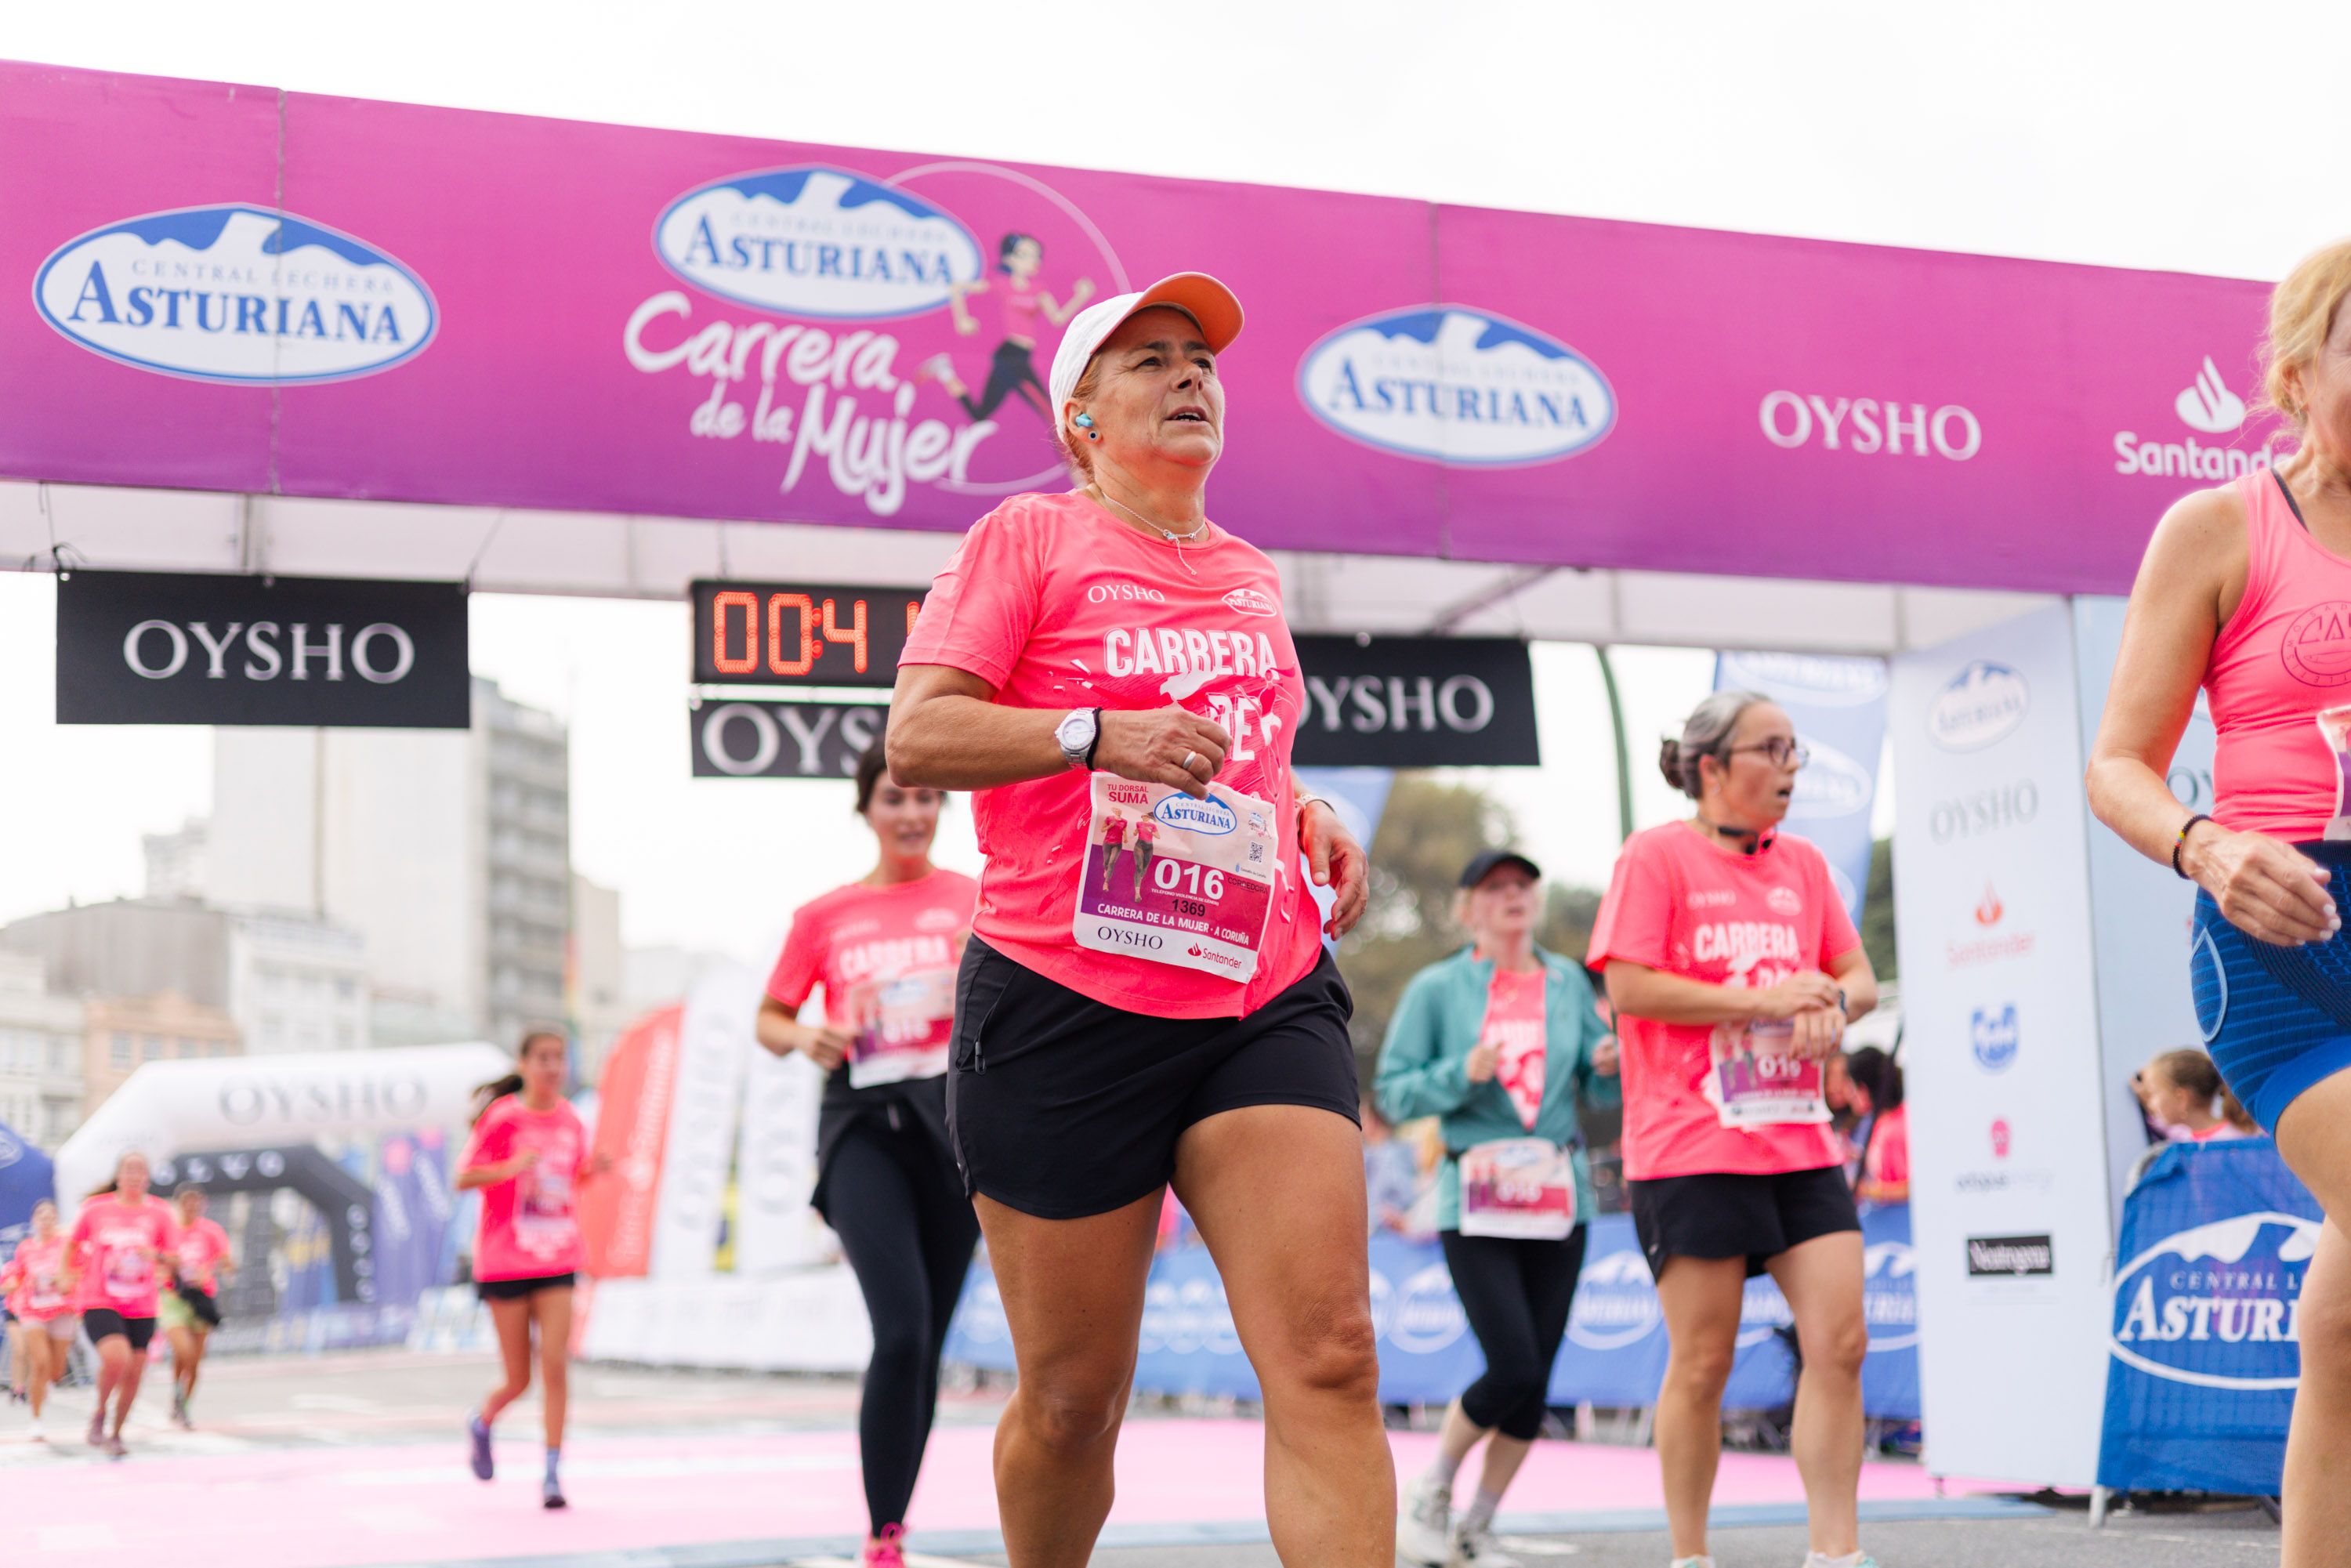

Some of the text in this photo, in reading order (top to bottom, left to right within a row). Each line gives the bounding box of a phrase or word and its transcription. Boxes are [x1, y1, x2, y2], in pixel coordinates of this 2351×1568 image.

[681, 212, 956, 285] ASTURIANA
[131, 259, 258, 284] CENTRAL
[67, 259, 405, 345] ASTURIANA
[624, 291, 899, 389] Carrera
[1329, 356, 1591, 432] ASTURIANA
[1759, 389, 1982, 461] OYSHO
[690, 381, 998, 516] de la Mujer
[1088, 584, 1166, 603] OYSHO
[123, 619, 415, 684] OYSHO
[1103, 628, 1281, 680] CARRERA
[1297, 674, 1495, 734] YSHO
[1108, 791, 1149, 805] SUMA
[1118, 784, 1150, 793] DORSAL
[1161, 802, 1231, 830] ASTURIANA
[1929, 777, 2039, 846] OYSHO
[1154, 858, 1225, 900] 016
[1098, 903, 1250, 946] CARRERA DE LA MUJER A CORUÑA
[1172, 899, 1205, 917] 1369
[1097, 925, 1163, 950] OYSHO
[1202, 947, 1242, 969] Santander
[1694, 921, 1801, 963] CARRERA
[218, 1067, 429, 1127] OYSHO
[2169, 1270, 2278, 1291] CENTRAL
